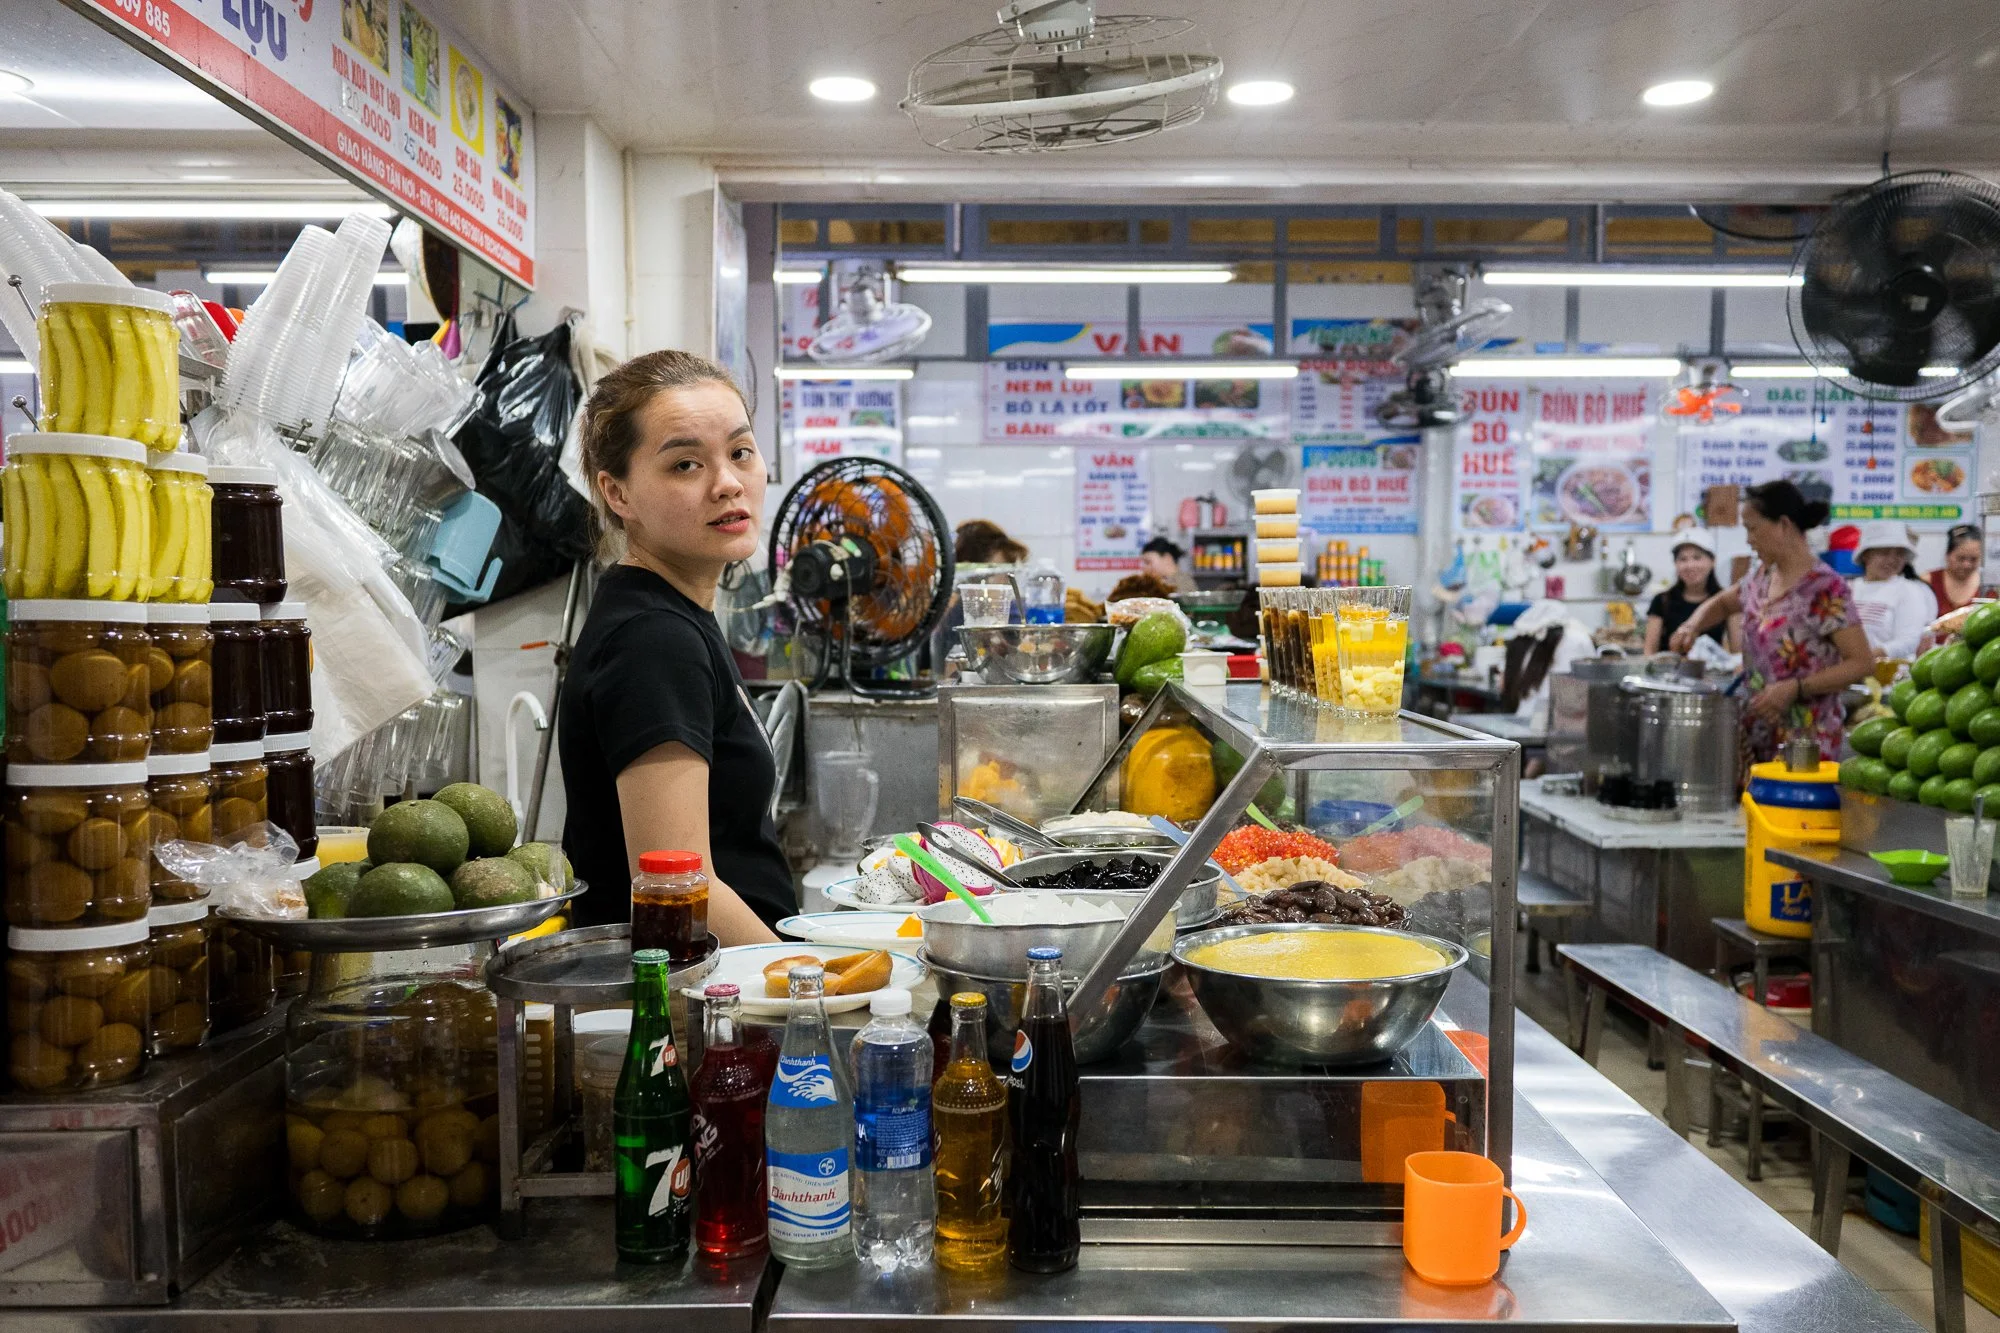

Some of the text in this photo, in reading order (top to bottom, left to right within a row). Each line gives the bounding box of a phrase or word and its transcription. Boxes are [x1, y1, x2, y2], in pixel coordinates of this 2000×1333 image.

[145, 6, 171, 38] 885
[337, 131, 360, 162] GIAO
[362, 147, 385, 179] HÀNG
[1005, 380, 1054, 393] NEM
[1471, 416, 1509, 444] BÒ
[1091, 450, 1135, 467] VÂN
[1462, 448, 1516, 476] HUẾ
